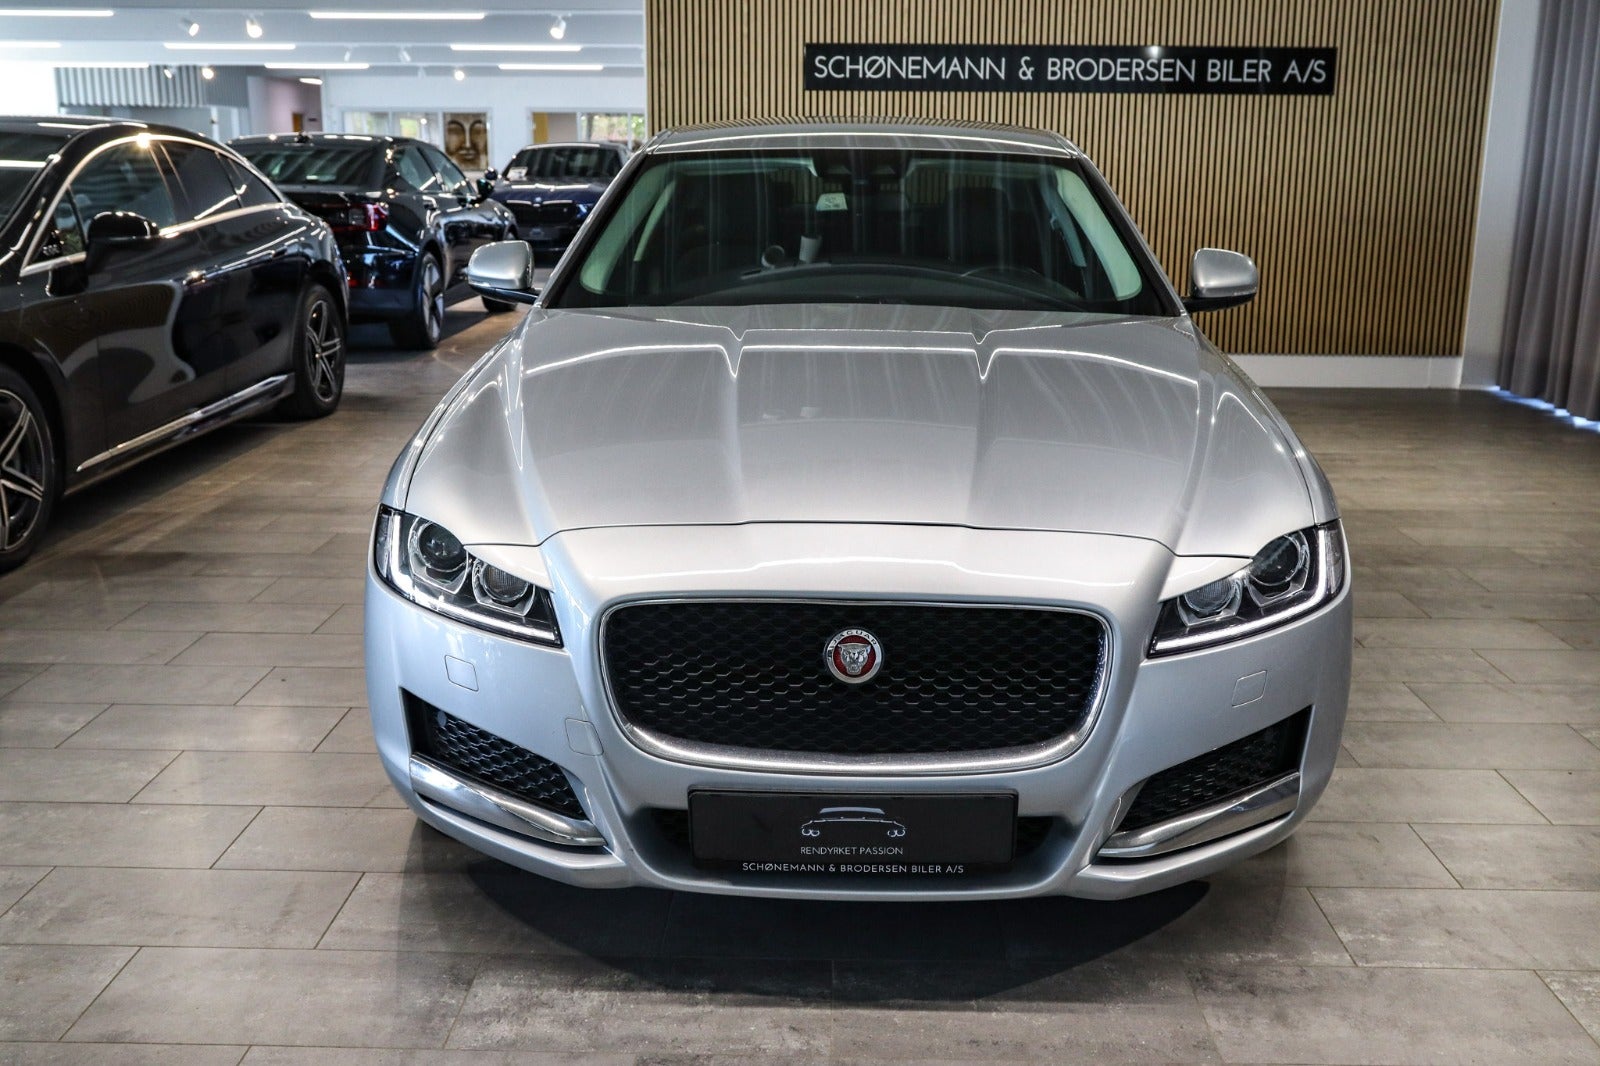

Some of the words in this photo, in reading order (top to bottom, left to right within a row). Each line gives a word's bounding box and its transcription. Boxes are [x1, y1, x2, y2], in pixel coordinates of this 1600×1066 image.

[814, 54, 1005, 81] SCHØNEMANN
[1018, 56, 1033, 80] &
[1047, 57, 1196, 83] BRODERSEN
[1207, 59, 1272, 83] BILER
[1284, 61, 1327, 84] A/S
[800, 846, 857, 855] RENDYRKET
[859, 846, 903, 855] PASSION
[742, 862, 825, 872] SCHØNEMANN
[828, 863, 837, 872] &
[840, 864, 907, 873] BRODERSEN
[911, 865, 942, 874] BILER
[946, 865, 964, 874] A/S
